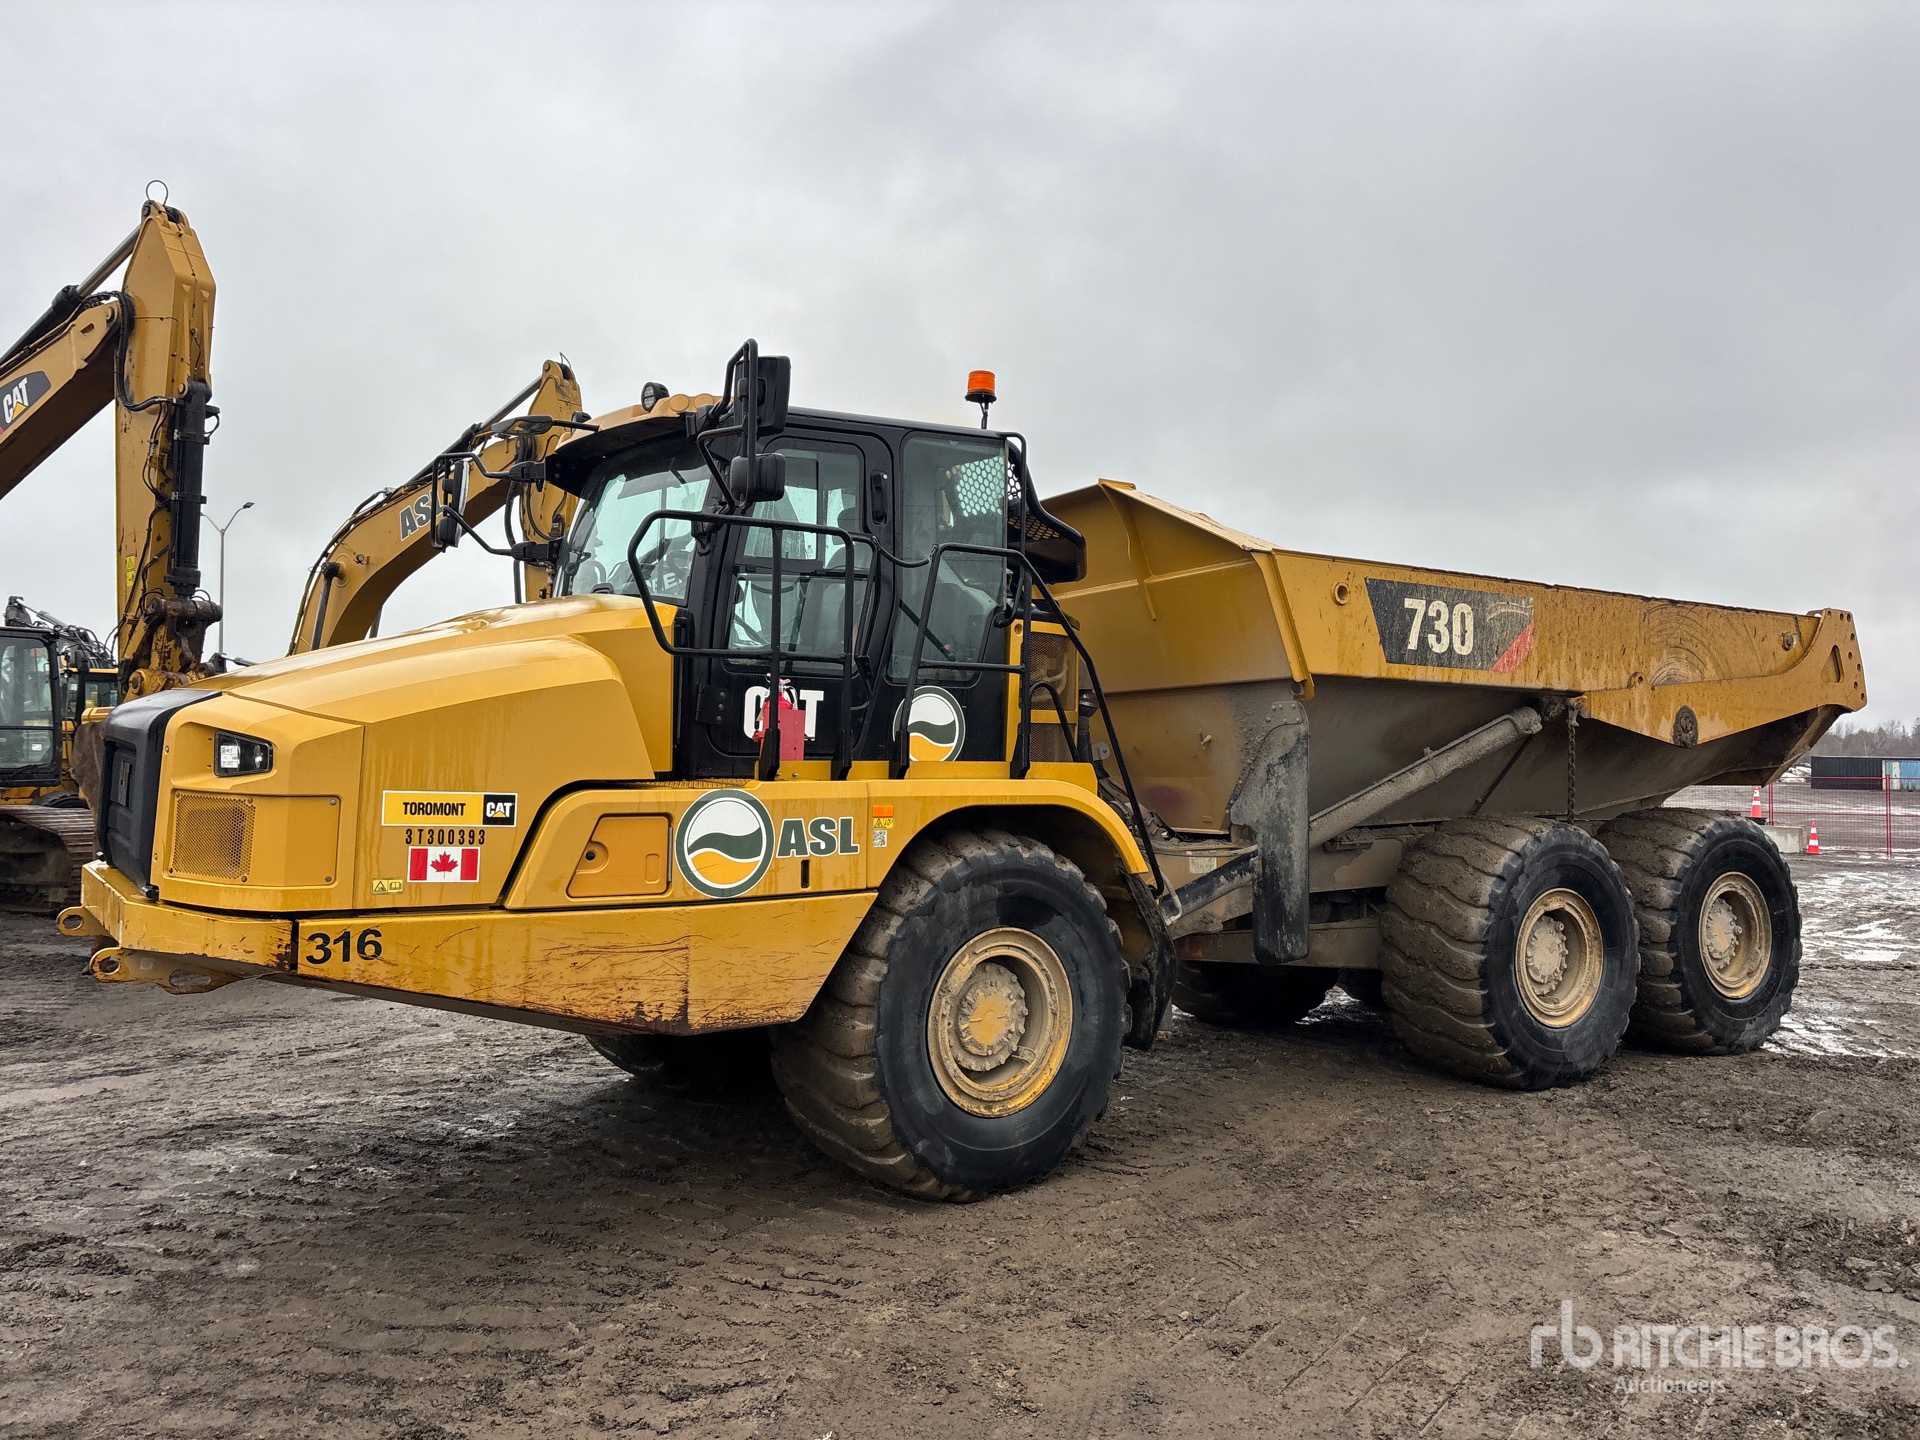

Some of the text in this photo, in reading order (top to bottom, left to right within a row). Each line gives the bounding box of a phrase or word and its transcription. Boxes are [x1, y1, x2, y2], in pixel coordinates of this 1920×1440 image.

[2, 377, 29, 424] CAT
[1404, 597, 1474, 655] 730
[743, 686, 825, 741] CT
[402, 801, 467, 816] TOROMONT
[486, 801, 514, 818] CAT
[405, 828, 486, 845] 3T300393
[776, 816, 860, 858] ASL
[305, 928, 383, 965] 316
